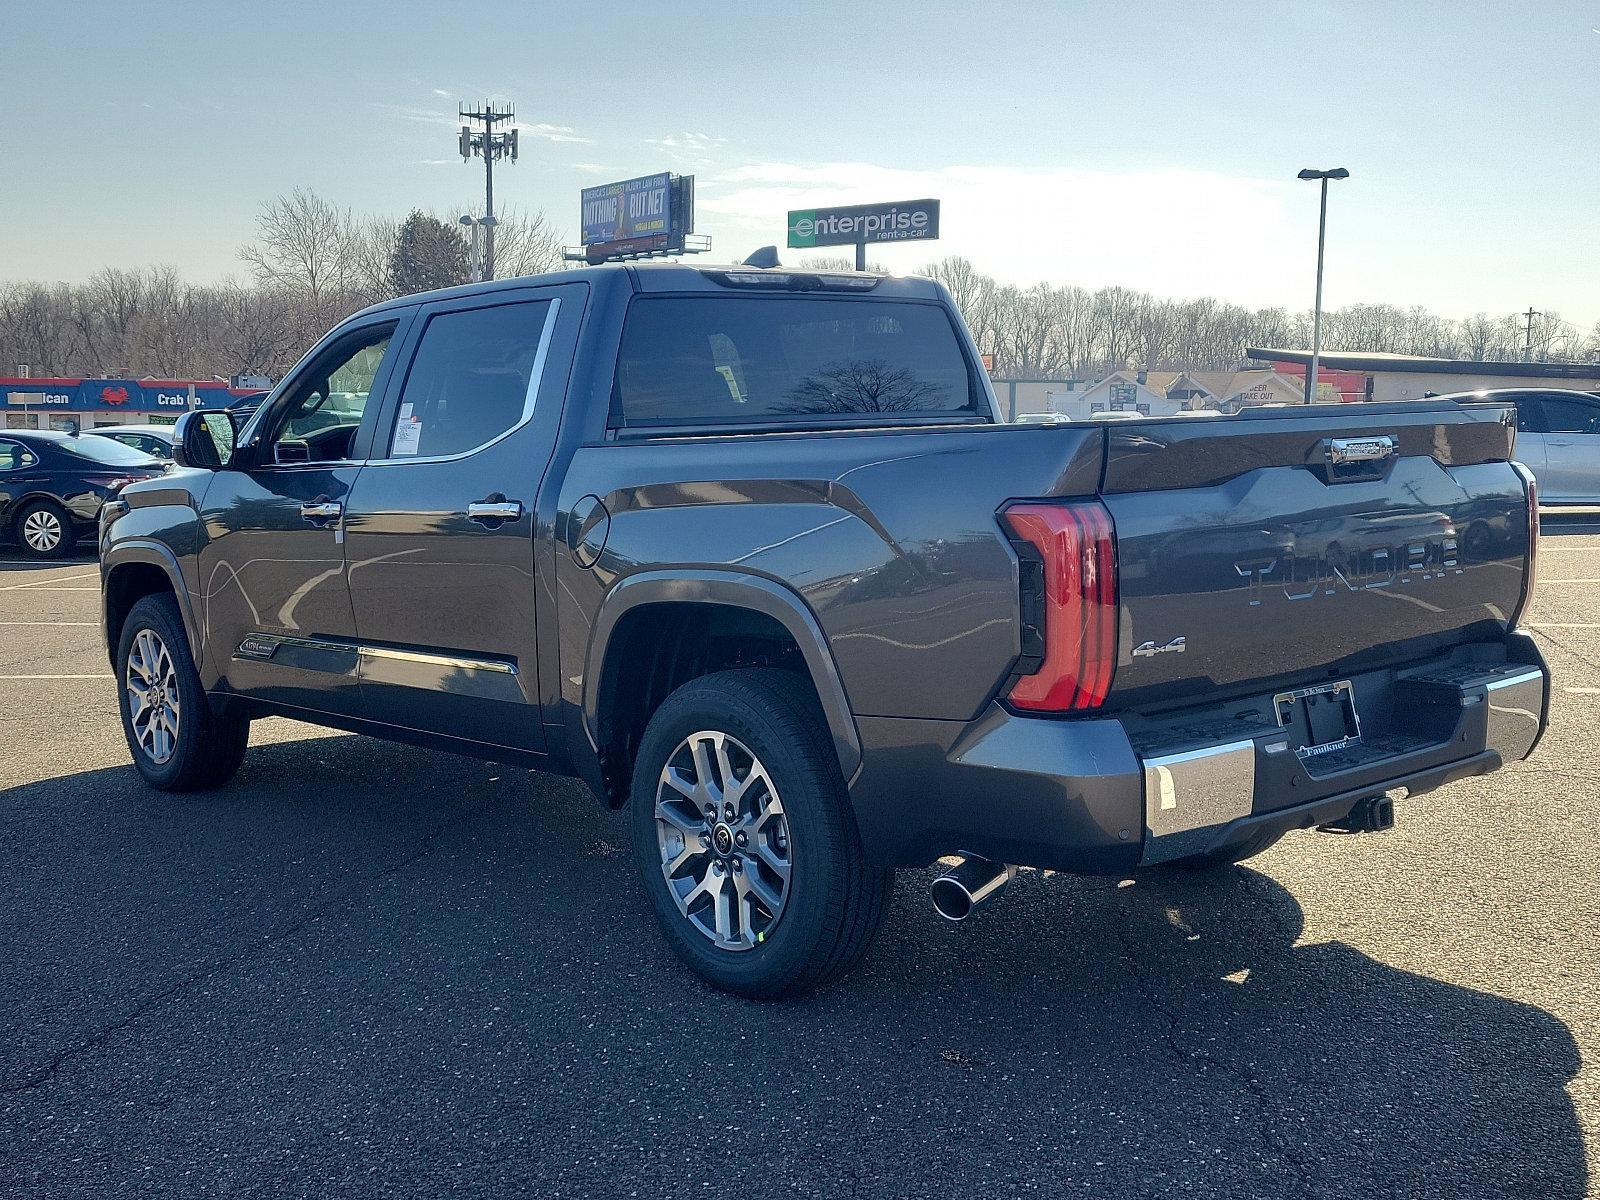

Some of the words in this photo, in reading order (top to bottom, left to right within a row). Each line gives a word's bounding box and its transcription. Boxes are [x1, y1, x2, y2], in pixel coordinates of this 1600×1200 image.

[584, 198, 617, 226] NOTHING
[630, 191, 647, 219] BUT
[648, 188, 666, 215] NET
[789, 208, 928, 237] enterprise
[877, 228, 928, 240] rent-a-car
[158, 394, 184, 405] Crab
[1260, 392, 1274, 400] OUT
[1234, 538, 1464, 606] TUNDRA
[1133, 636, 1186, 657] 4x4
[1306, 741, 1347, 757] Faulkner
